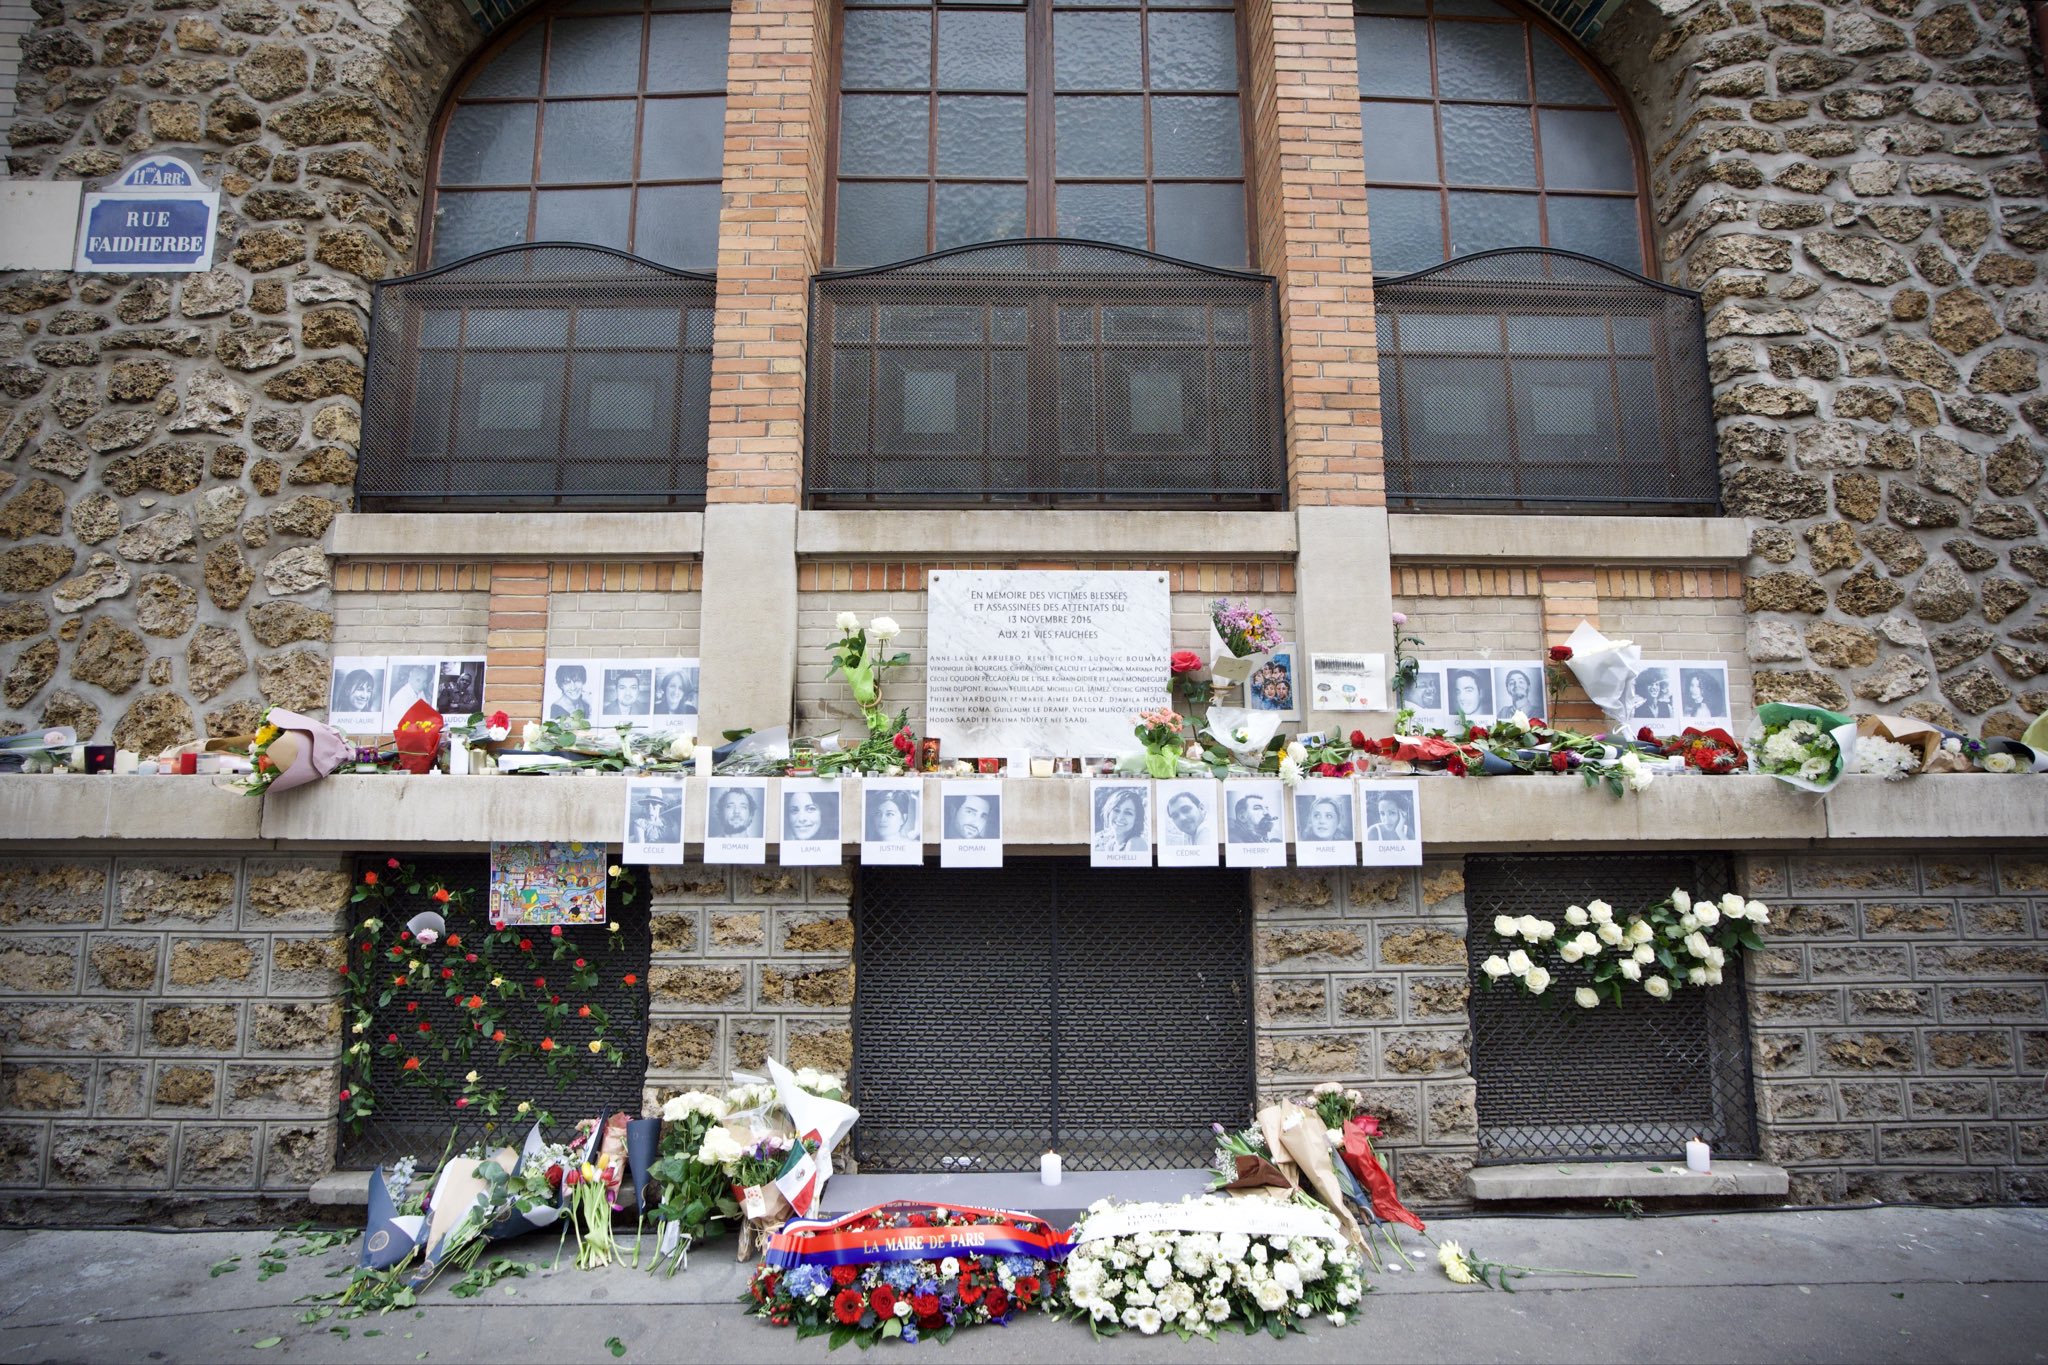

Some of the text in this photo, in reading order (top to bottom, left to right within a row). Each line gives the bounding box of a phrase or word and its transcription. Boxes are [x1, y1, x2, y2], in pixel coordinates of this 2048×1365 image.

[126, 211, 170, 227] RUE
[88, 236, 203, 253] FAIDHERBE
[971, 591, 983, 600] EN
[1030, 591, 1046, 600] DES
[1047, 591, 1089, 600] VICTIMES
[974, 603, 984, 612] ET
[1043, 603, 1060, 612] DES
[1061, 603, 1110, 612] ATTENTATS
[1112, 603, 1125, 612] DU
[1008, 615, 1092, 624] 13 NOVEMBRE 2015
[998, 630, 1018, 639] AUX
[1021, 630, 1031, 639] 21
[1033, 630, 1053, 639] VIES
[643, 845, 665, 855] CÉCILE
[721, 843, 749, 852] ROMAIN
[800, 846, 821, 854] LAMIA
[879, 844, 906, 853] JUSTINE
[958, 844, 986, 853] ROMAIN
[1242, 847, 1270, 856] THIERRY
[1315, 845, 1336, 854] MARIE
[1378, 845, 1406, 854] DJAMILA
[1106, 853, 1137, 862] MICHELLI
[1175, 848, 1201, 858] CÉDRIC
[863, 1231, 986, 1256] LA MAIRE DE PARIS
